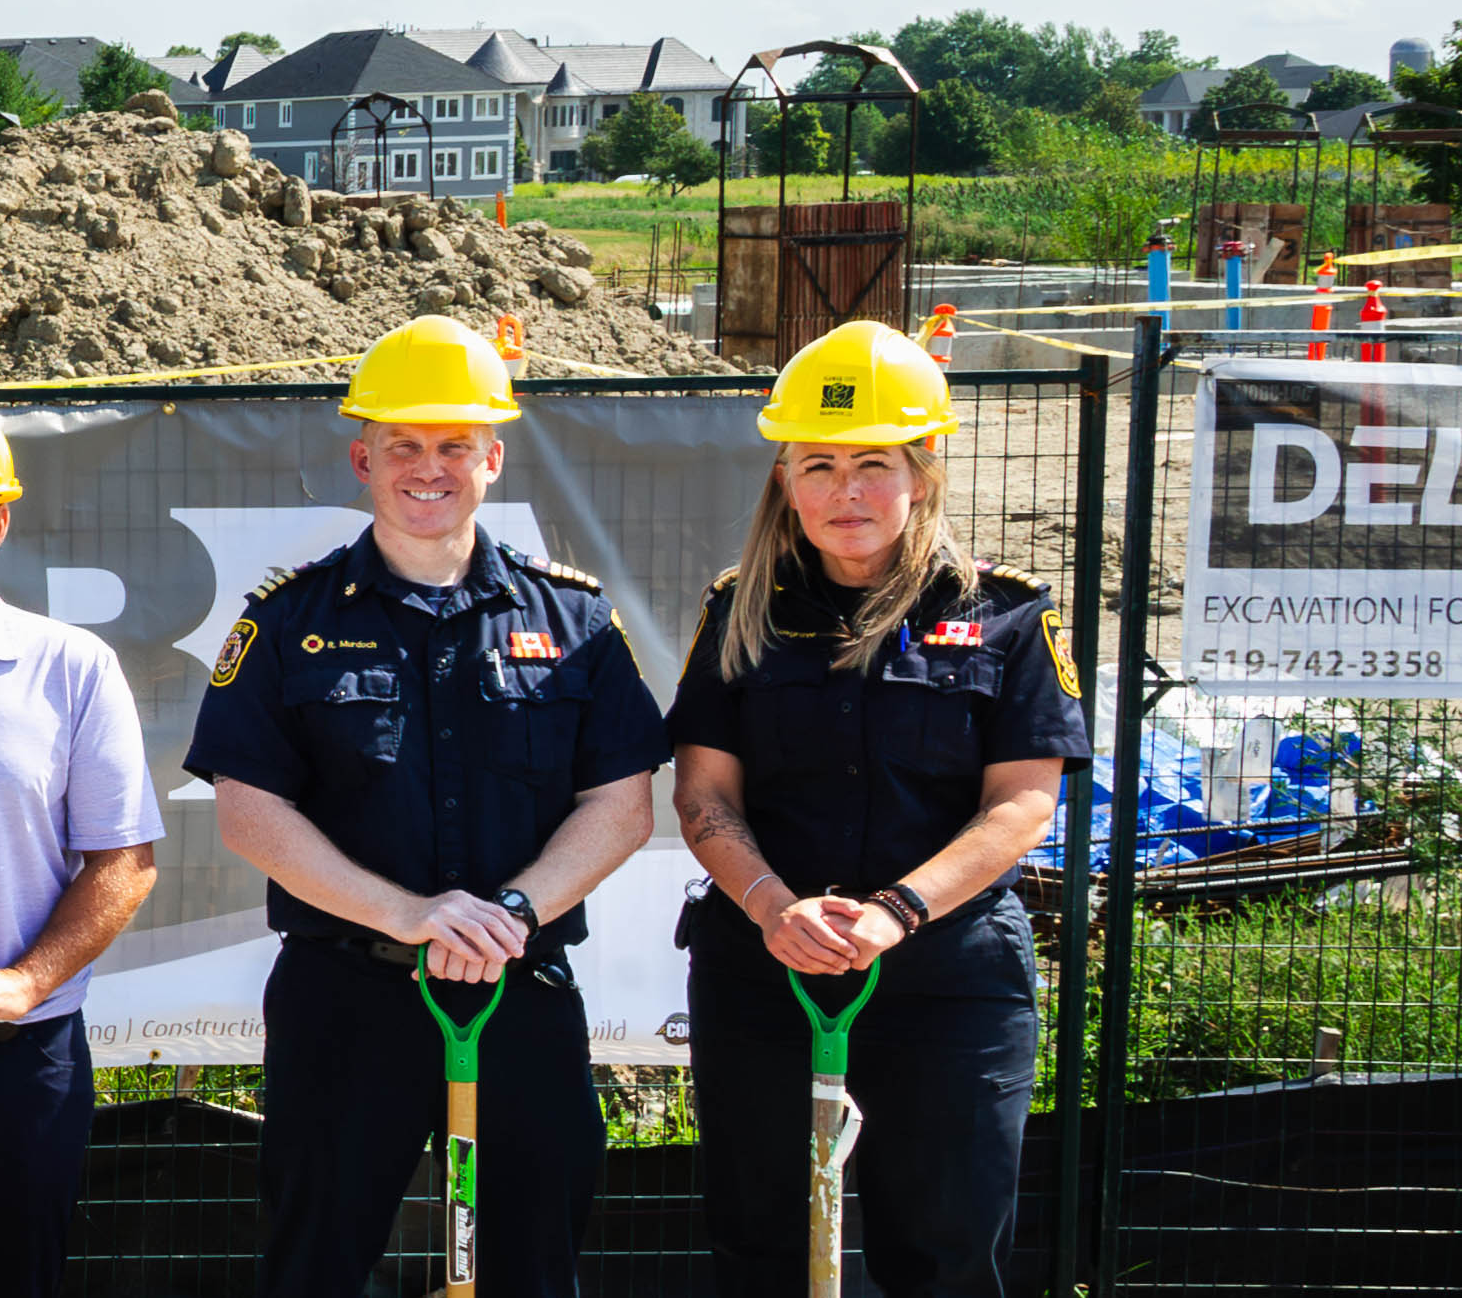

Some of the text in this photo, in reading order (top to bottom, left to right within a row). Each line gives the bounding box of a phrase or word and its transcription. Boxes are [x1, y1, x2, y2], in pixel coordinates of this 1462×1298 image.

[1204, 596, 1402, 624] EXCAVATION
[339, 640, 378, 649] Murdoch
[1200, 649, 1443, 678] 519-742-3358
